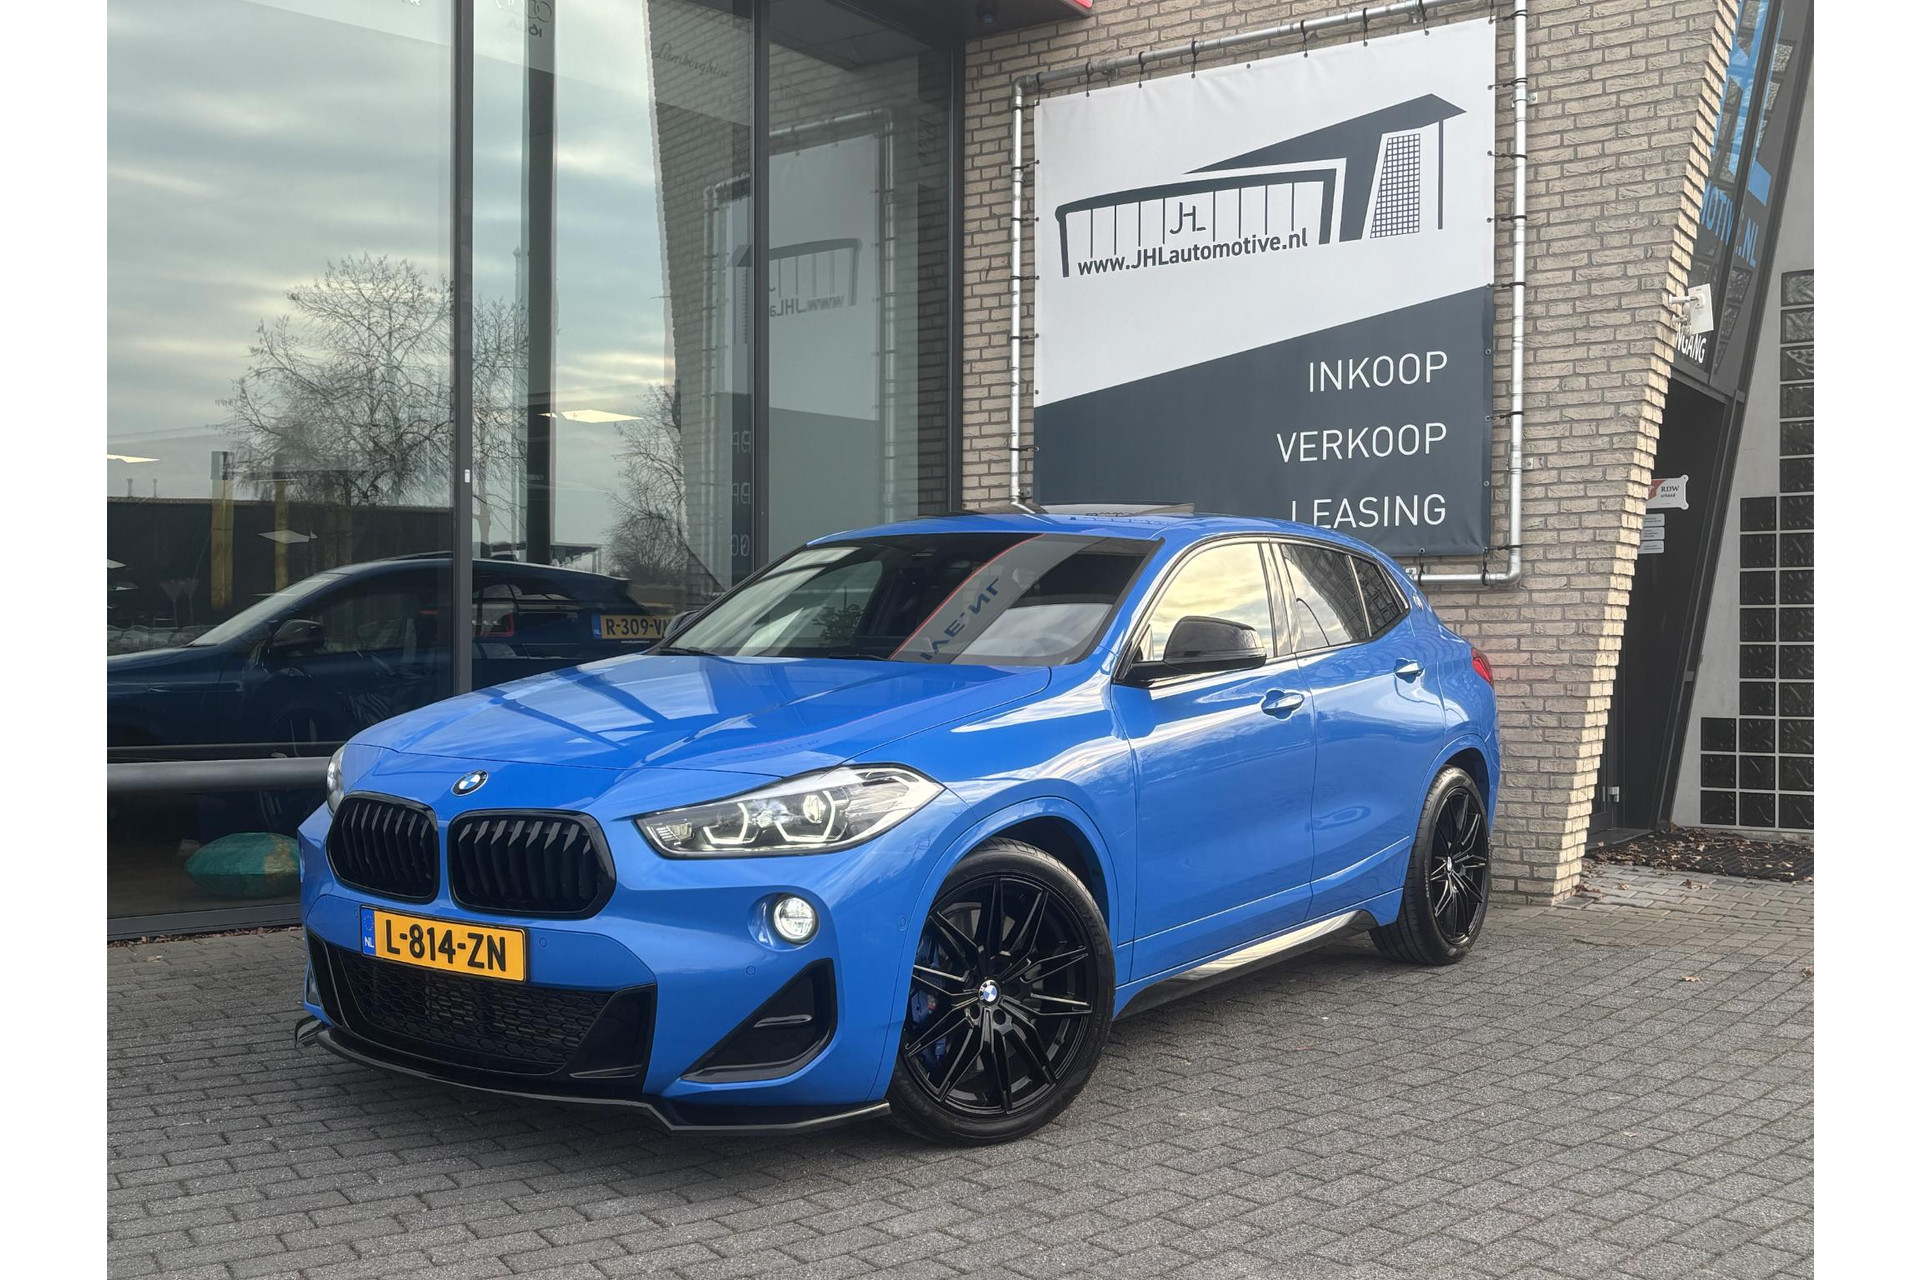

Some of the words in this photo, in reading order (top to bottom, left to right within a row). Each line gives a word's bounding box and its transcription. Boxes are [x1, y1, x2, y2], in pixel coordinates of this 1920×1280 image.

[1169, 202, 1207, 235] JHL
[1077, 227, 1308, 276] www.JHLautomotive.nl
[1309, 351, 1448, 393] INKOOP
[1276, 422, 1448, 463] VERKOOP
[1660, 485, 1680, 493] RDW
[364, 936, 375, 949] NL
[385, 919, 507, 972] L-814-ZN
